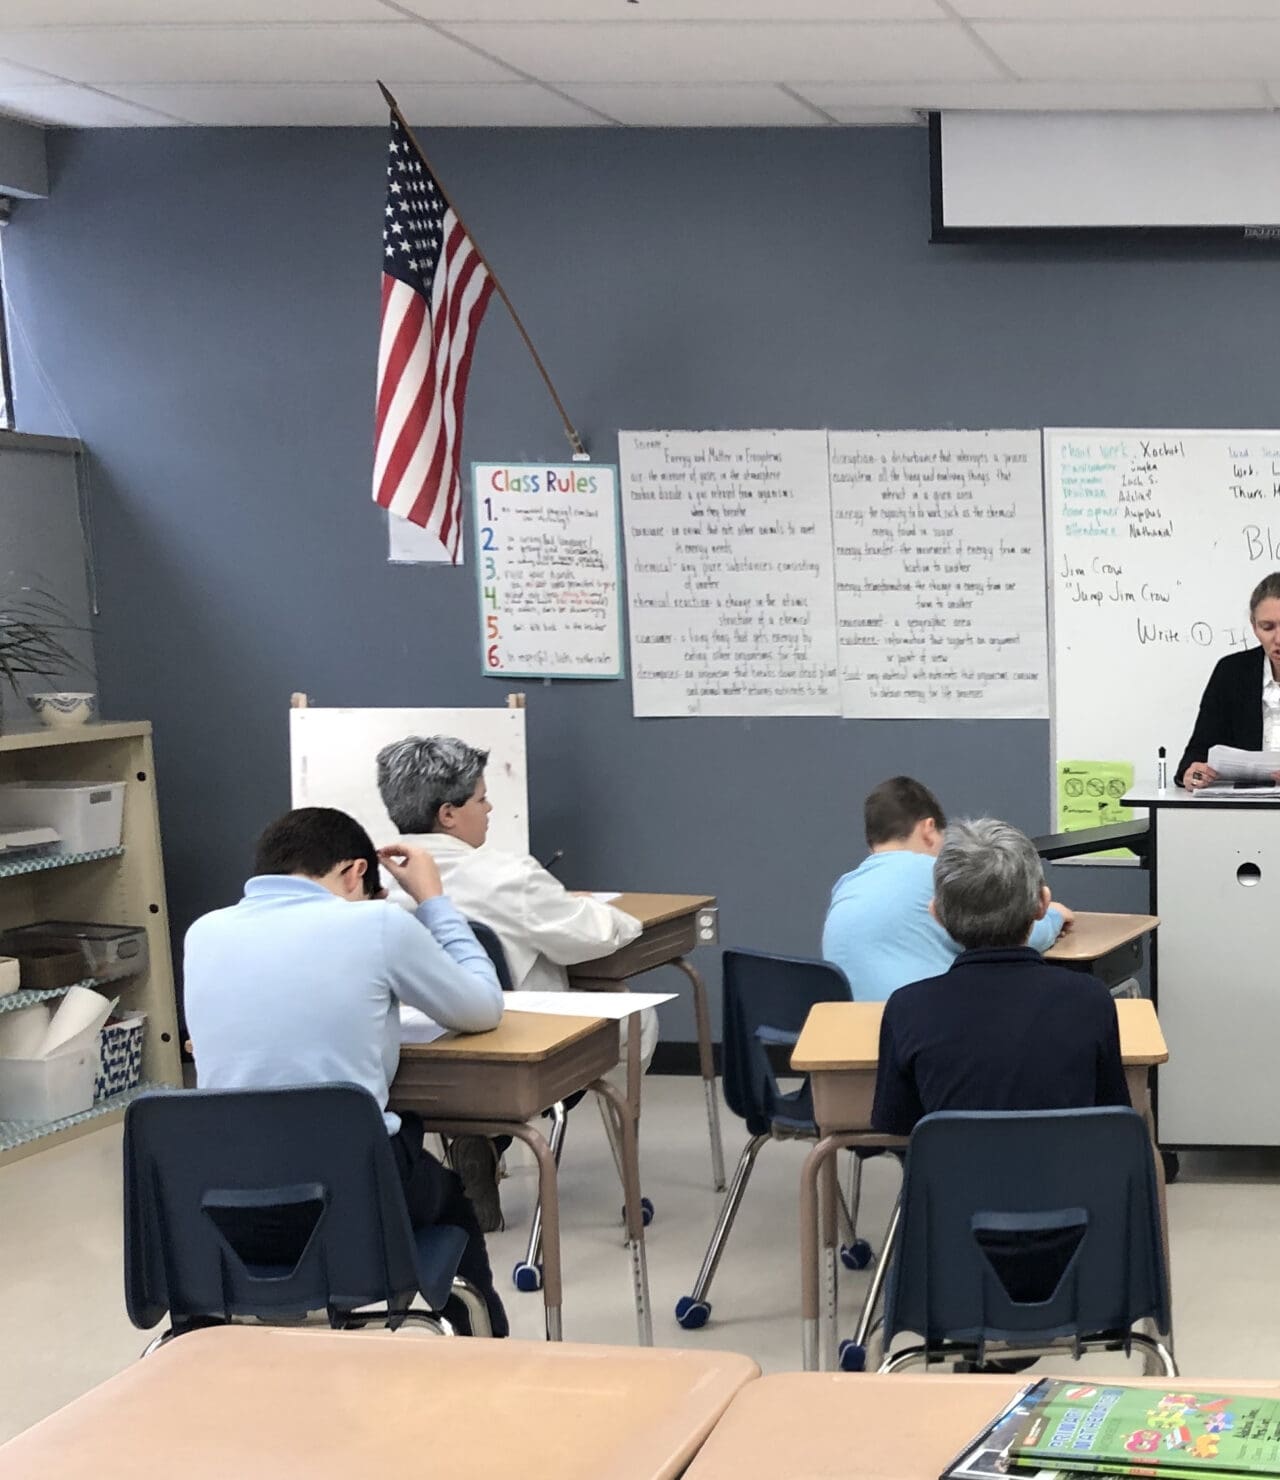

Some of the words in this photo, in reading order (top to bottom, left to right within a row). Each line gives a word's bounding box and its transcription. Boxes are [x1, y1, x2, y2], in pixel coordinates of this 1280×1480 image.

[492, 470, 540, 493] Class
[547, 470, 597, 493] Rules
[1229, 485, 1266, 499] Thurs.
[1061, 554, 1085, 578] Jim
[1092, 557, 1123, 576] Crow
[1109, 580, 1135, 601] Jim
